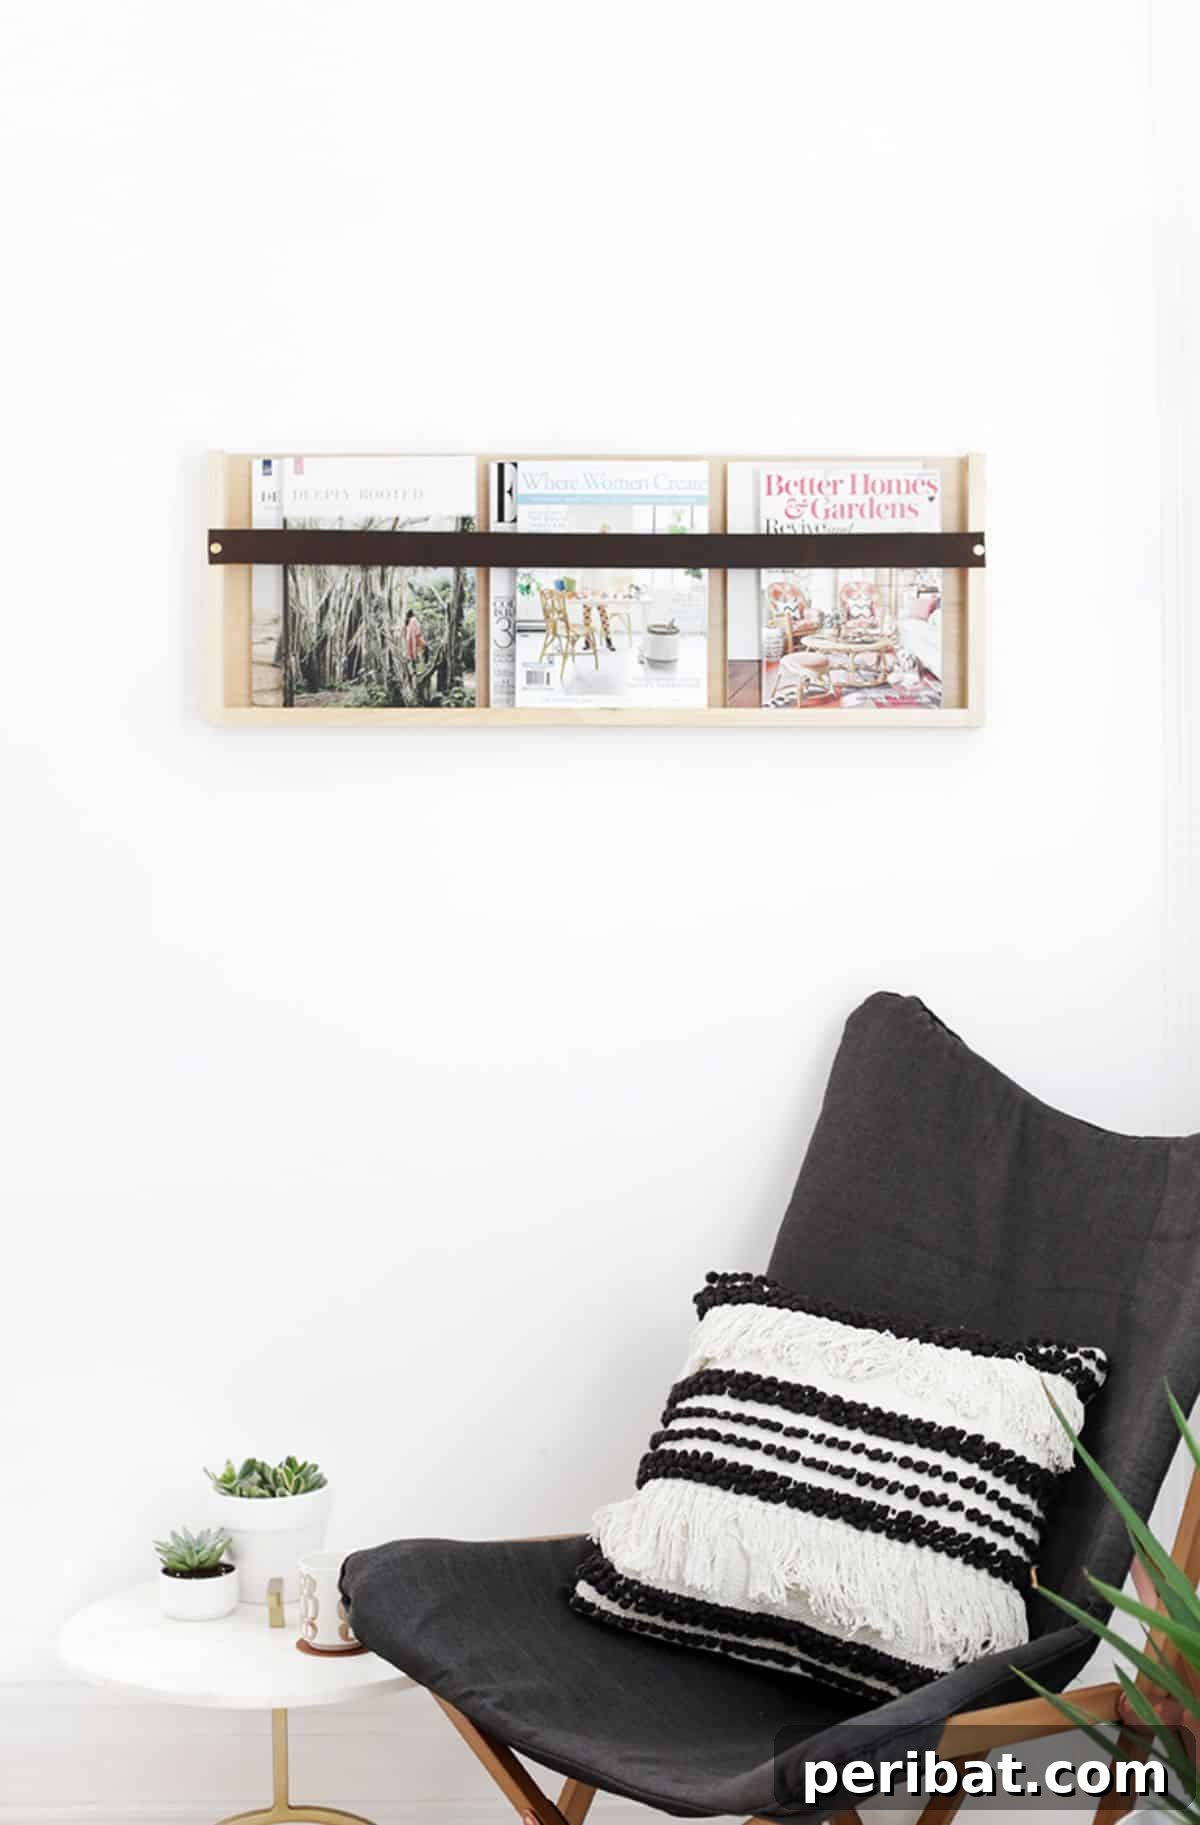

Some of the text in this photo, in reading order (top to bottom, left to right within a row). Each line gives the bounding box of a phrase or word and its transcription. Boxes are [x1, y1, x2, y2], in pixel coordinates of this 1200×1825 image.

[521, 472, 709, 491] Where Women Create
[765, 473, 939, 497] Better Homes
[291, 488, 425, 503] DEEPLY ROOTED
[810, 496, 920, 521] Gardens
